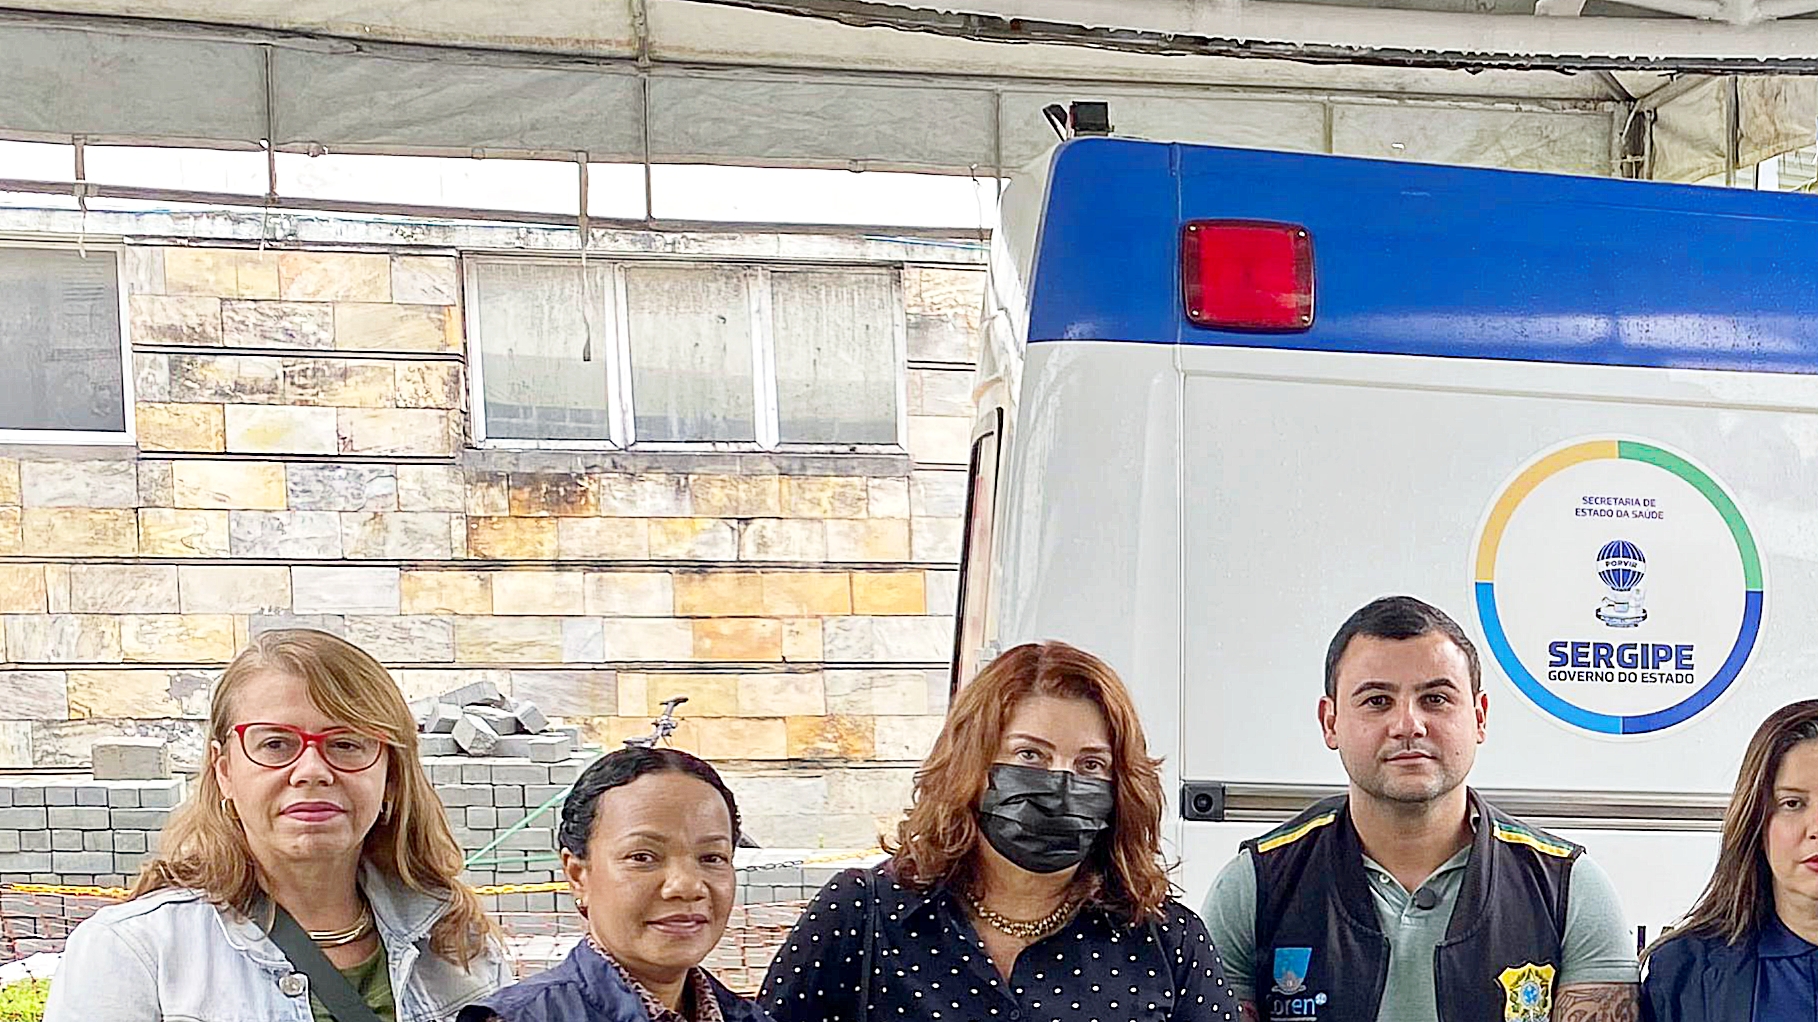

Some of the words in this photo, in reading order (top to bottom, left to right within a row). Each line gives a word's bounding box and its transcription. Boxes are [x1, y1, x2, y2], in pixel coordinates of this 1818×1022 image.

[1582, 496, 1641, 507] SECRETARIA
[1643, 498, 1656, 508] DE
[1575, 508, 1614, 518] ESTADO
[1616, 509, 1630, 519] DA
[1632, 508, 1665, 520] SAÚDE
[1548, 641, 1694, 670] SERGIPE
[1548, 670, 1615, 682] GOVERNO
[1618, 671, 1638, 683] DO
[1641, 672, 1695, 684] ESTADO
